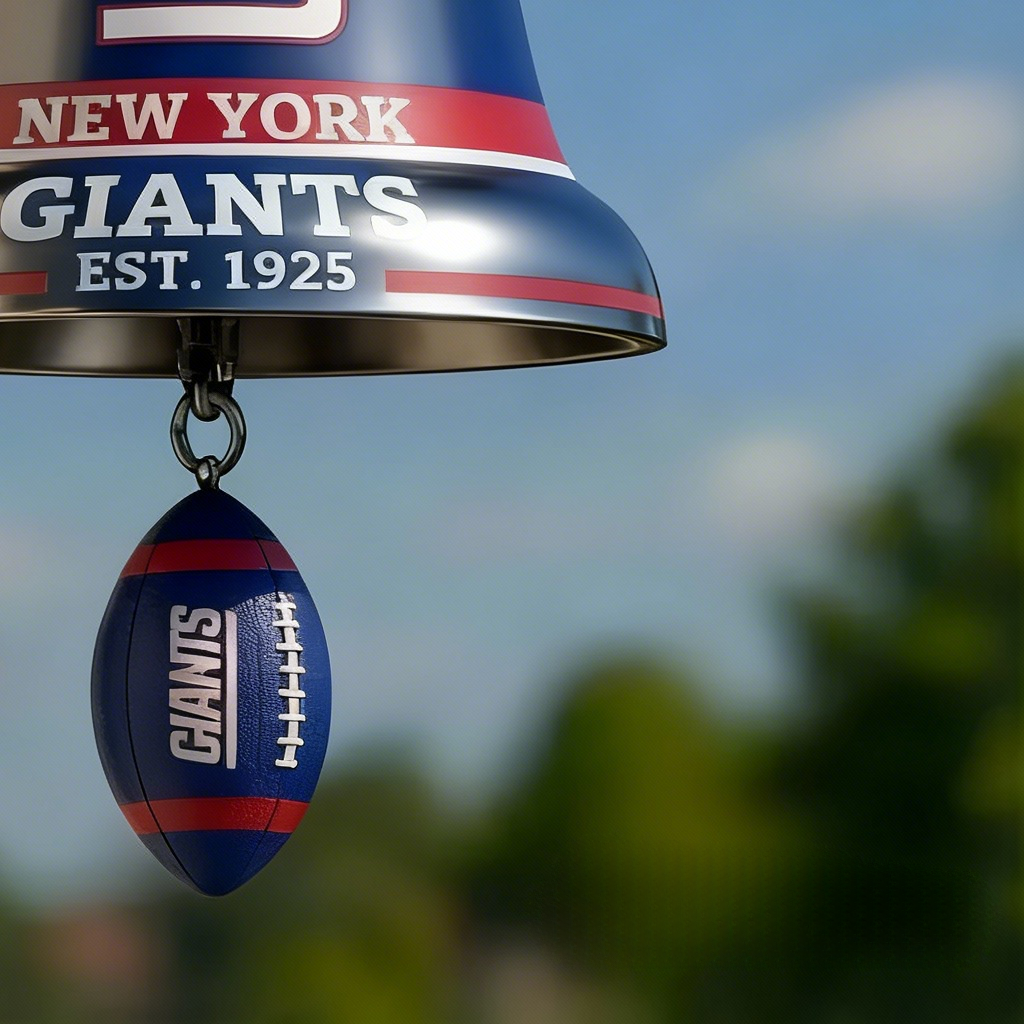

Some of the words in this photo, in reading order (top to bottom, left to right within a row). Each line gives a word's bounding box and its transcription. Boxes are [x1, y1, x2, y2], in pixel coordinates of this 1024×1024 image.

[12, 92, 189, 145] NEW
[206, 92, 416, 144] YORK
[0, 173, 429, 243] GIANTS
[75, 250, 202, 291] EST.
[224, 250, 357, 292] 1925
[169, 604, 223, 765] GIANTS
